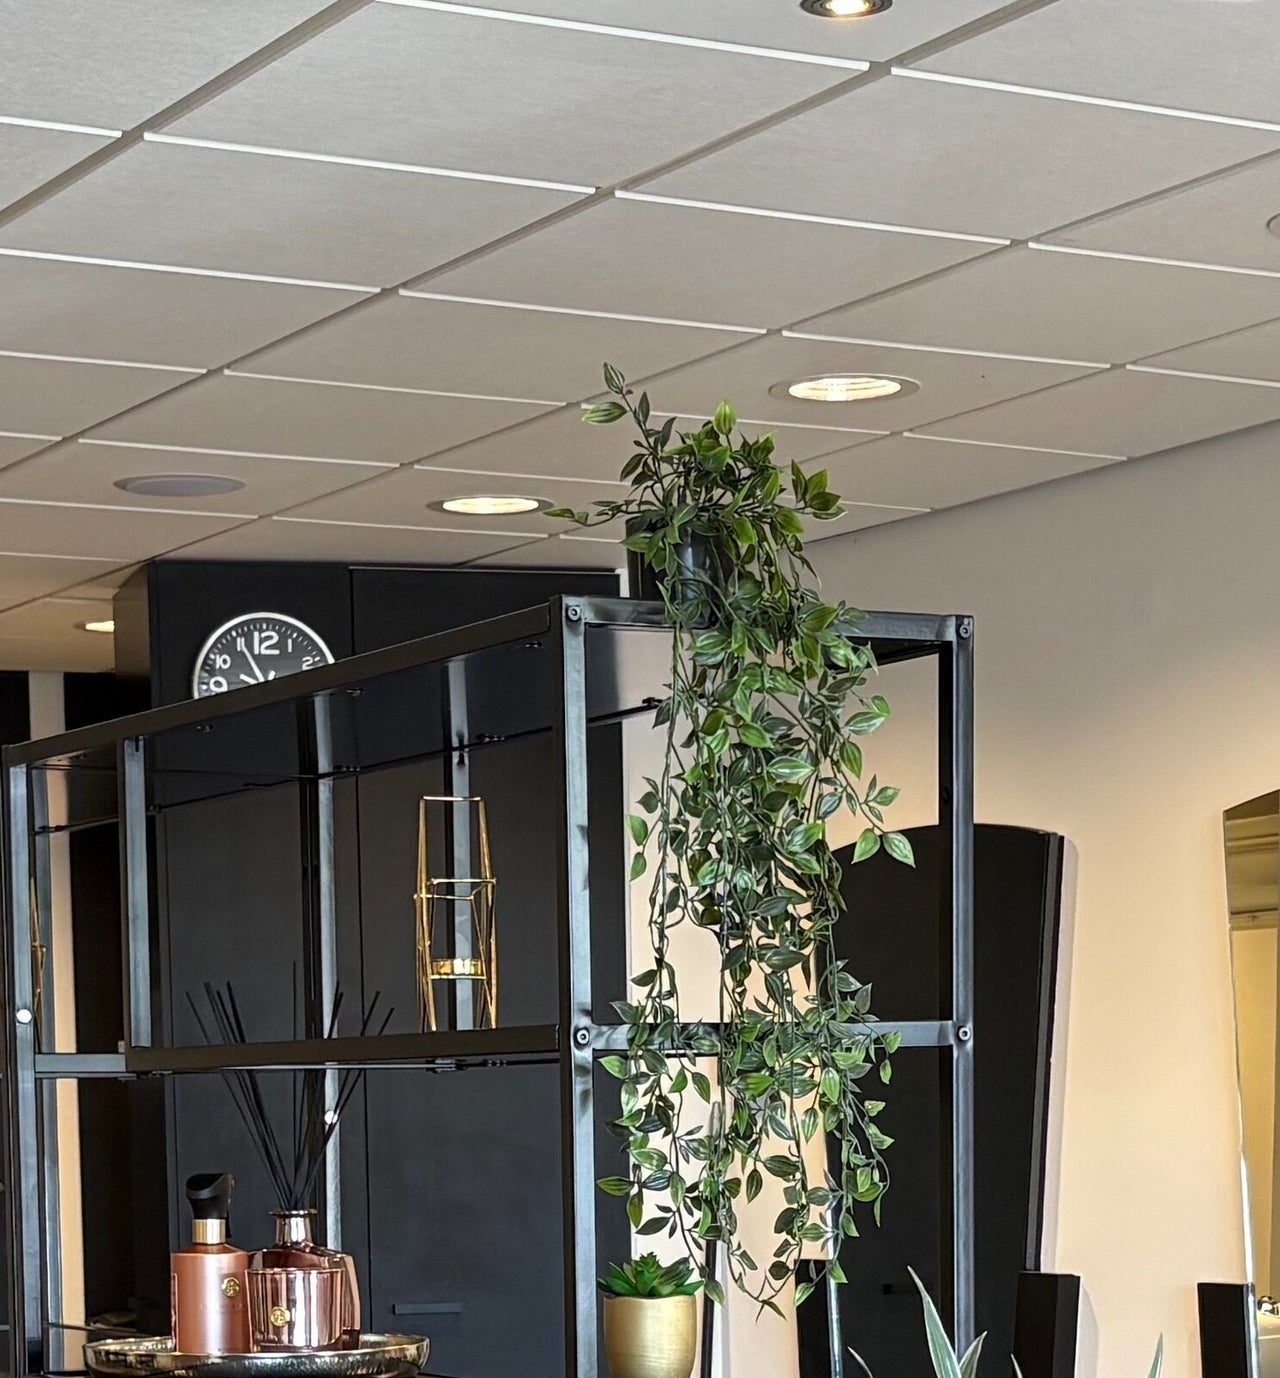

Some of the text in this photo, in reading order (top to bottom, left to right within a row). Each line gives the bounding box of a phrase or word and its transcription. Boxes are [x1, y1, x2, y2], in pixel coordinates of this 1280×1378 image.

[254, 631, 280, 655] 12
[215, 654, 231, 670] 10
[302, 656, 315, 671] 2
